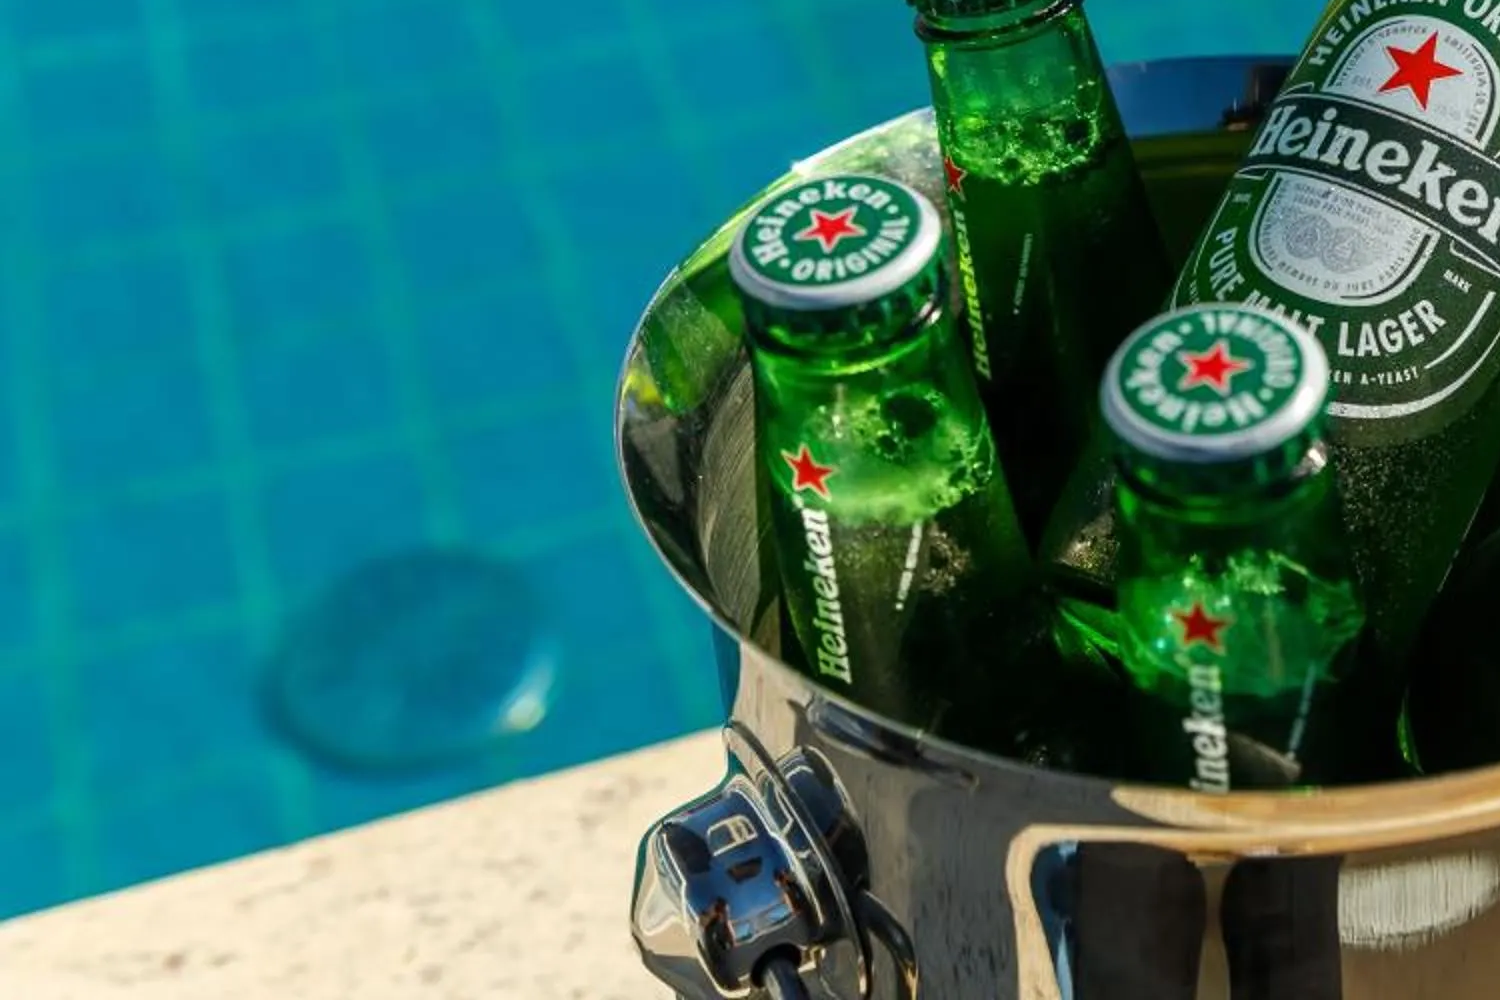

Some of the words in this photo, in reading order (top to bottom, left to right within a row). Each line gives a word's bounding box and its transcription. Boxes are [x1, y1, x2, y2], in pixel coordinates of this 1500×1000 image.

[752, 180, 892, 266] Heineken
[791, 214, 910, 282] ORIGINAL
[1209, 226, 1245, 301] PURE
[1337, 299, 1447, 357] LAGER
[1360, 365, 1420, 385] A-YEAST
[801, 506, 852, 684] Heineken
[1182, 664, 1231, 795] ineken
